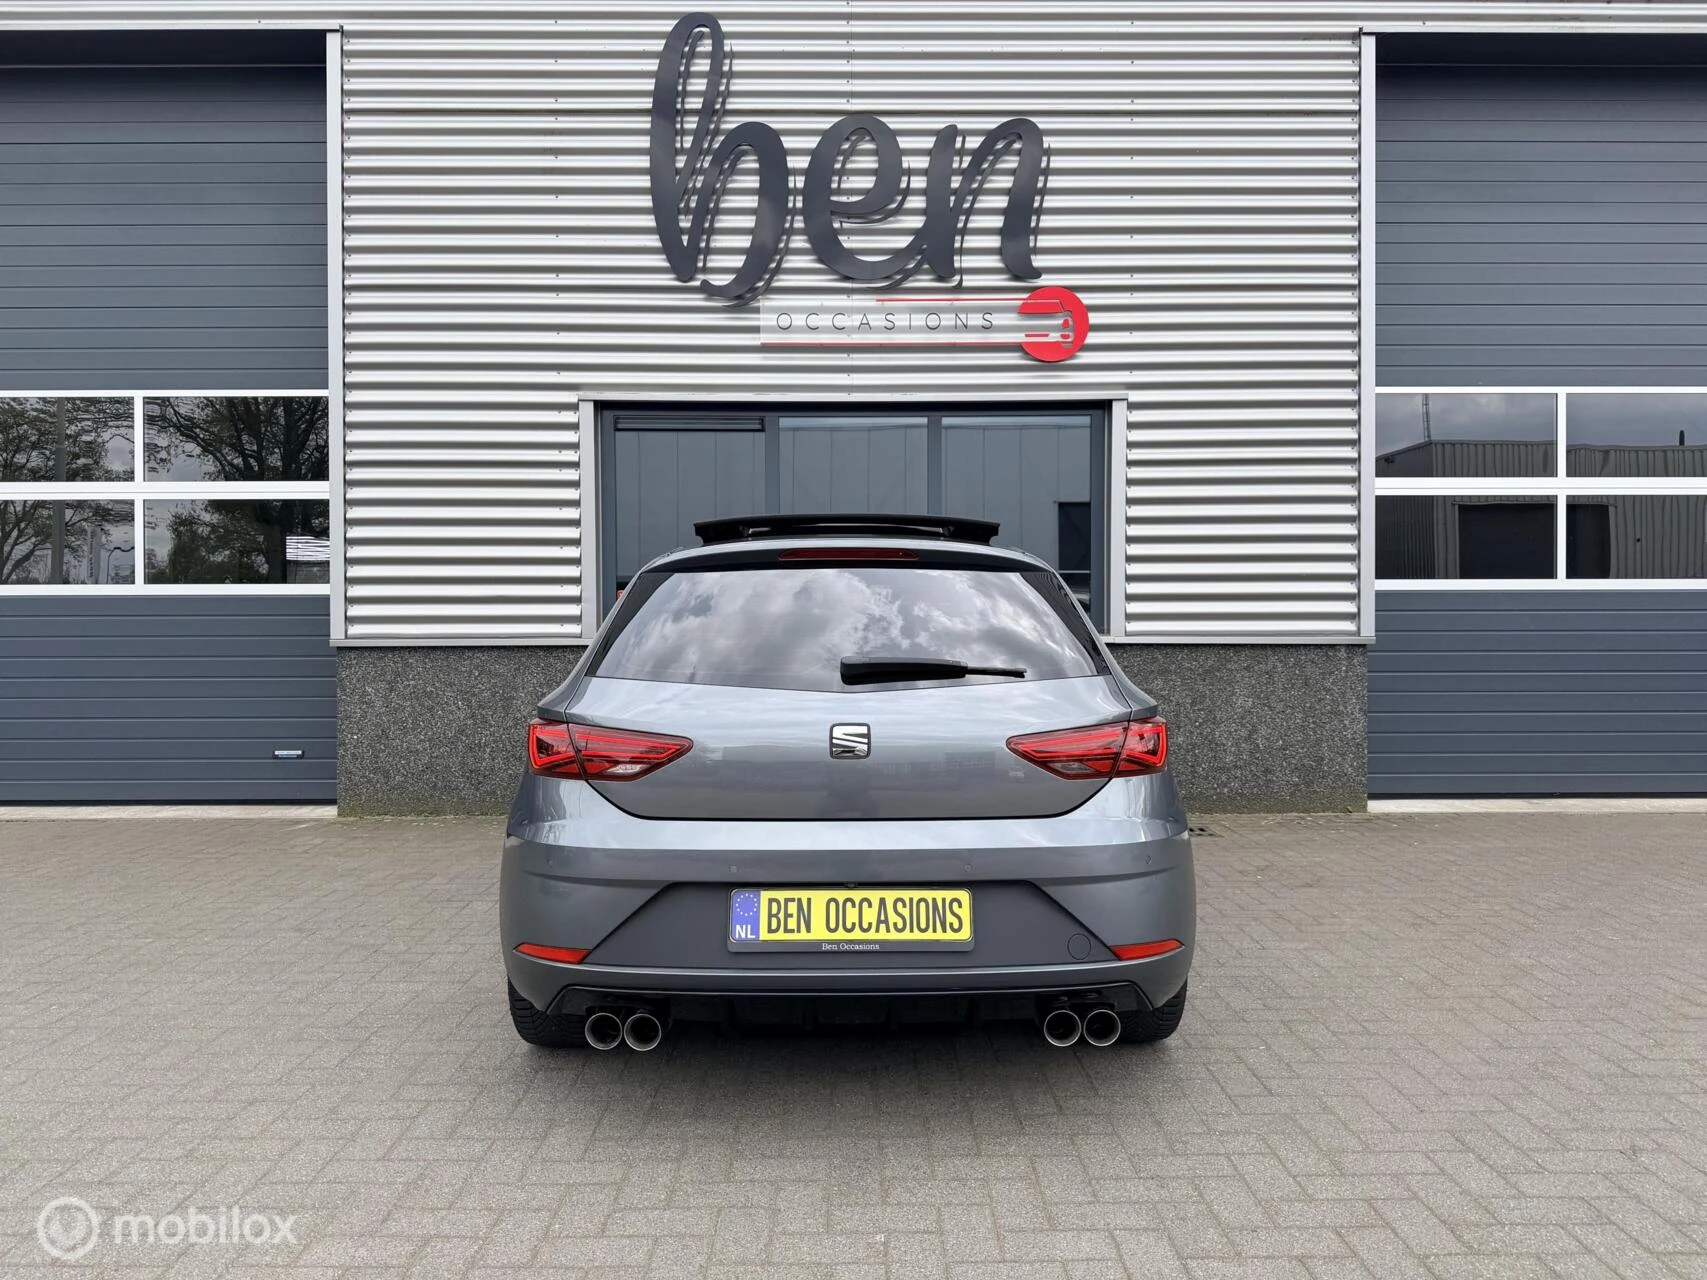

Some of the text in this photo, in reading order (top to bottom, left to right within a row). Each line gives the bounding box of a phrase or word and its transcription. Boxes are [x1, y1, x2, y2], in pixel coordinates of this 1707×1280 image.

[650, 12, 1043, 298] ben
[776, 312, 993, 331] OCCASIONS
[766, 897, 964, 934] BEN OCCASIONS
[735, 924, 756, 939] NL
[822, 942, 880, 950] Ben Occasions
